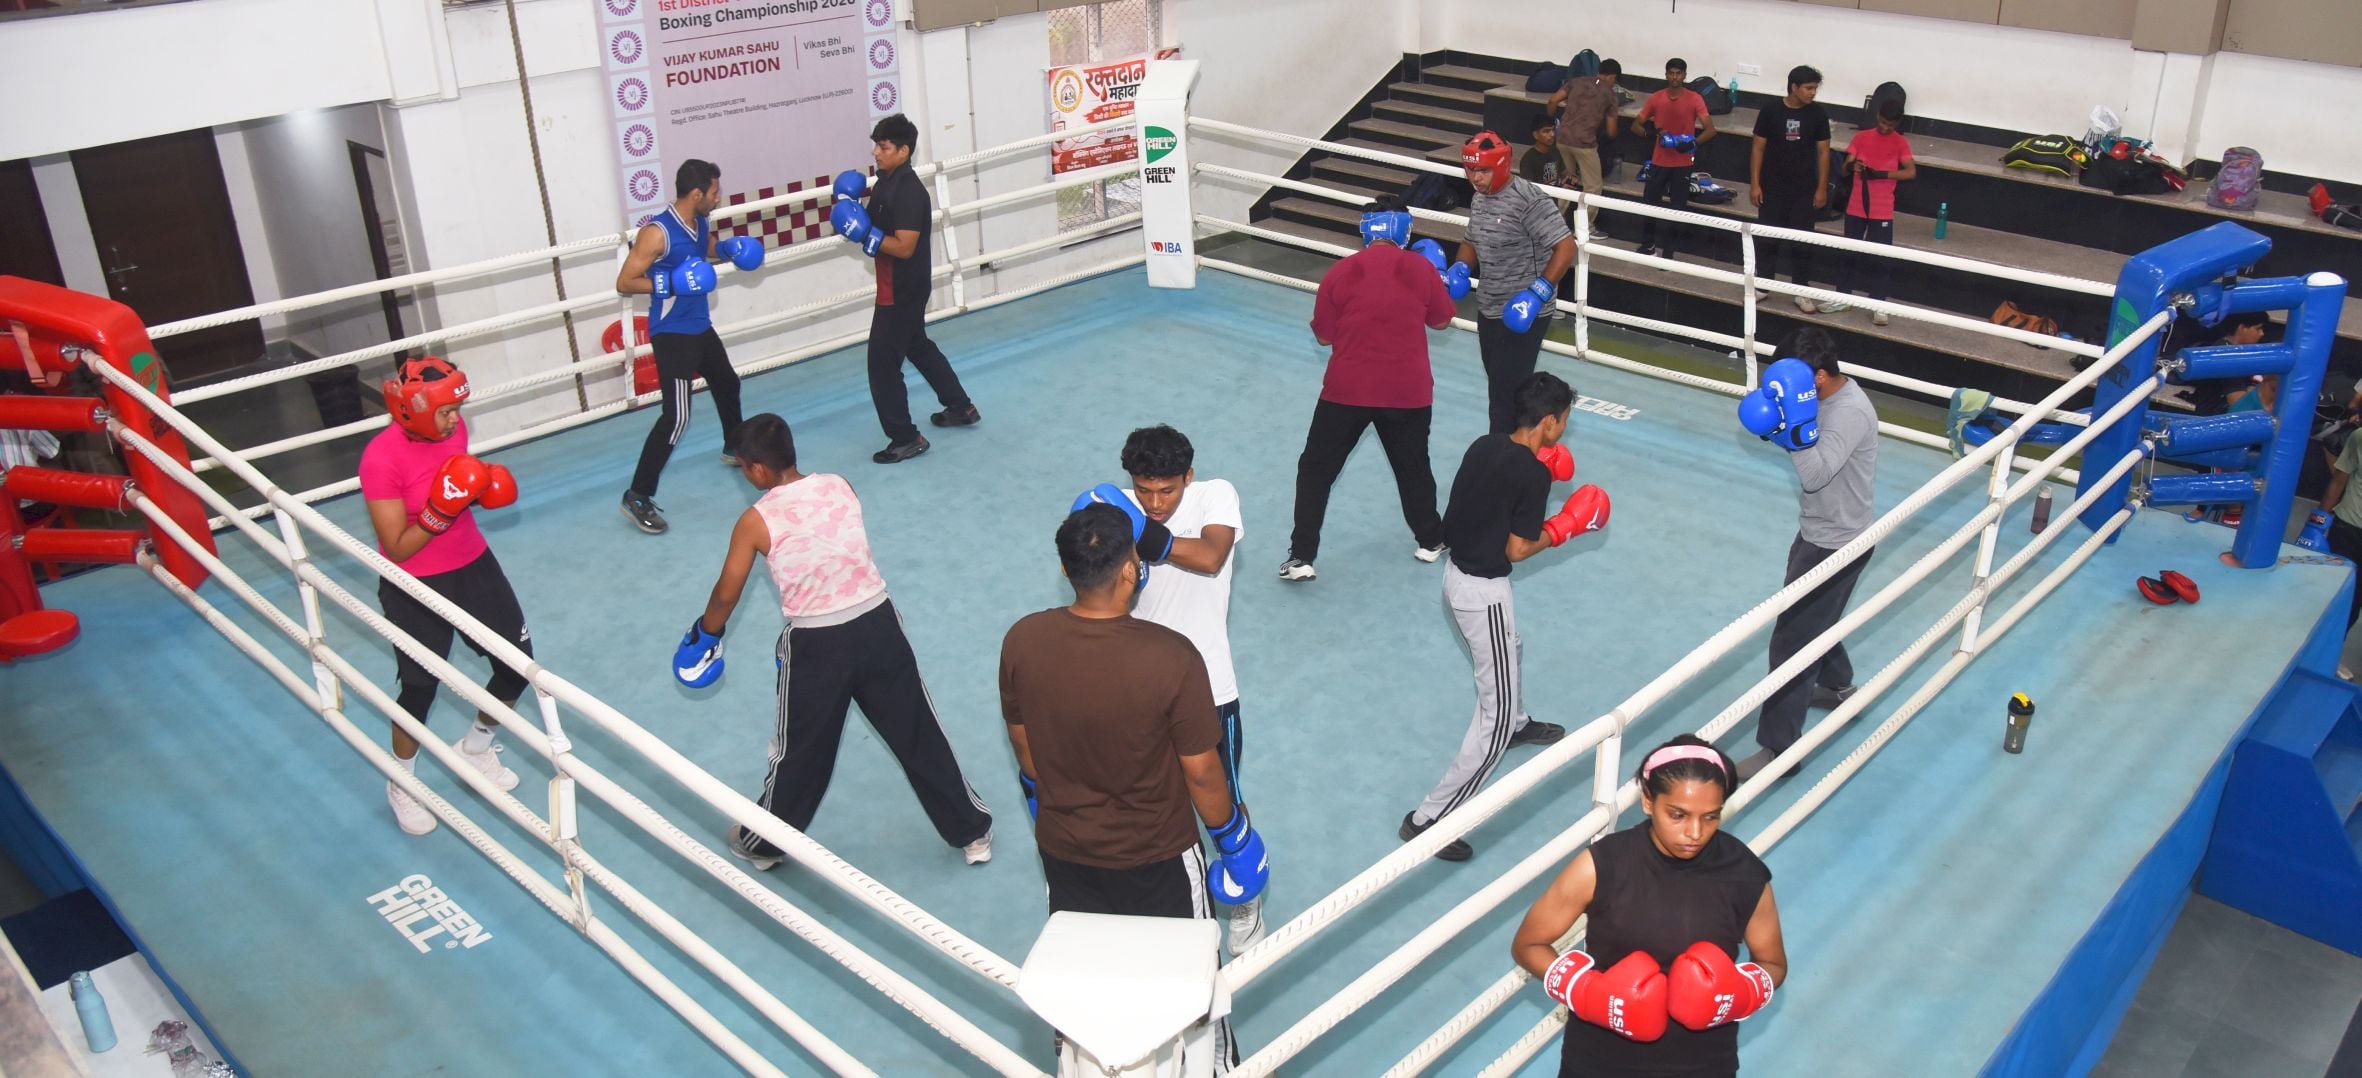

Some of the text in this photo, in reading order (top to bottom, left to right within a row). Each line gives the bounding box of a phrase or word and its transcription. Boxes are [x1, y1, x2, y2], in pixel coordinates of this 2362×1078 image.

[658, 0, 729, 11] 1st Distr
[660, 12, 712, 30] Boxing
[716, 0, 818, 22] Championship
[803, 36, 842, 50] Vikas Bhi
[820, 44, 856, 58] Seva Bhi
[664, 41, 780, 66] VIJAY KUMAR SAHU
[666, 57, 781, 88] FOUNDATION
[1083, 59, 1146, 97] रक्तदान
[1109, 84, 1141, 100] महादा
[1144, 167, 1176, 175] GREEN
[1146, 174, 1172, 184] HILL
[1164, 242, 1182, 253] IBA
[366, 885, 446, 954] HILL
[400, 874, 493, 949] GREEN
